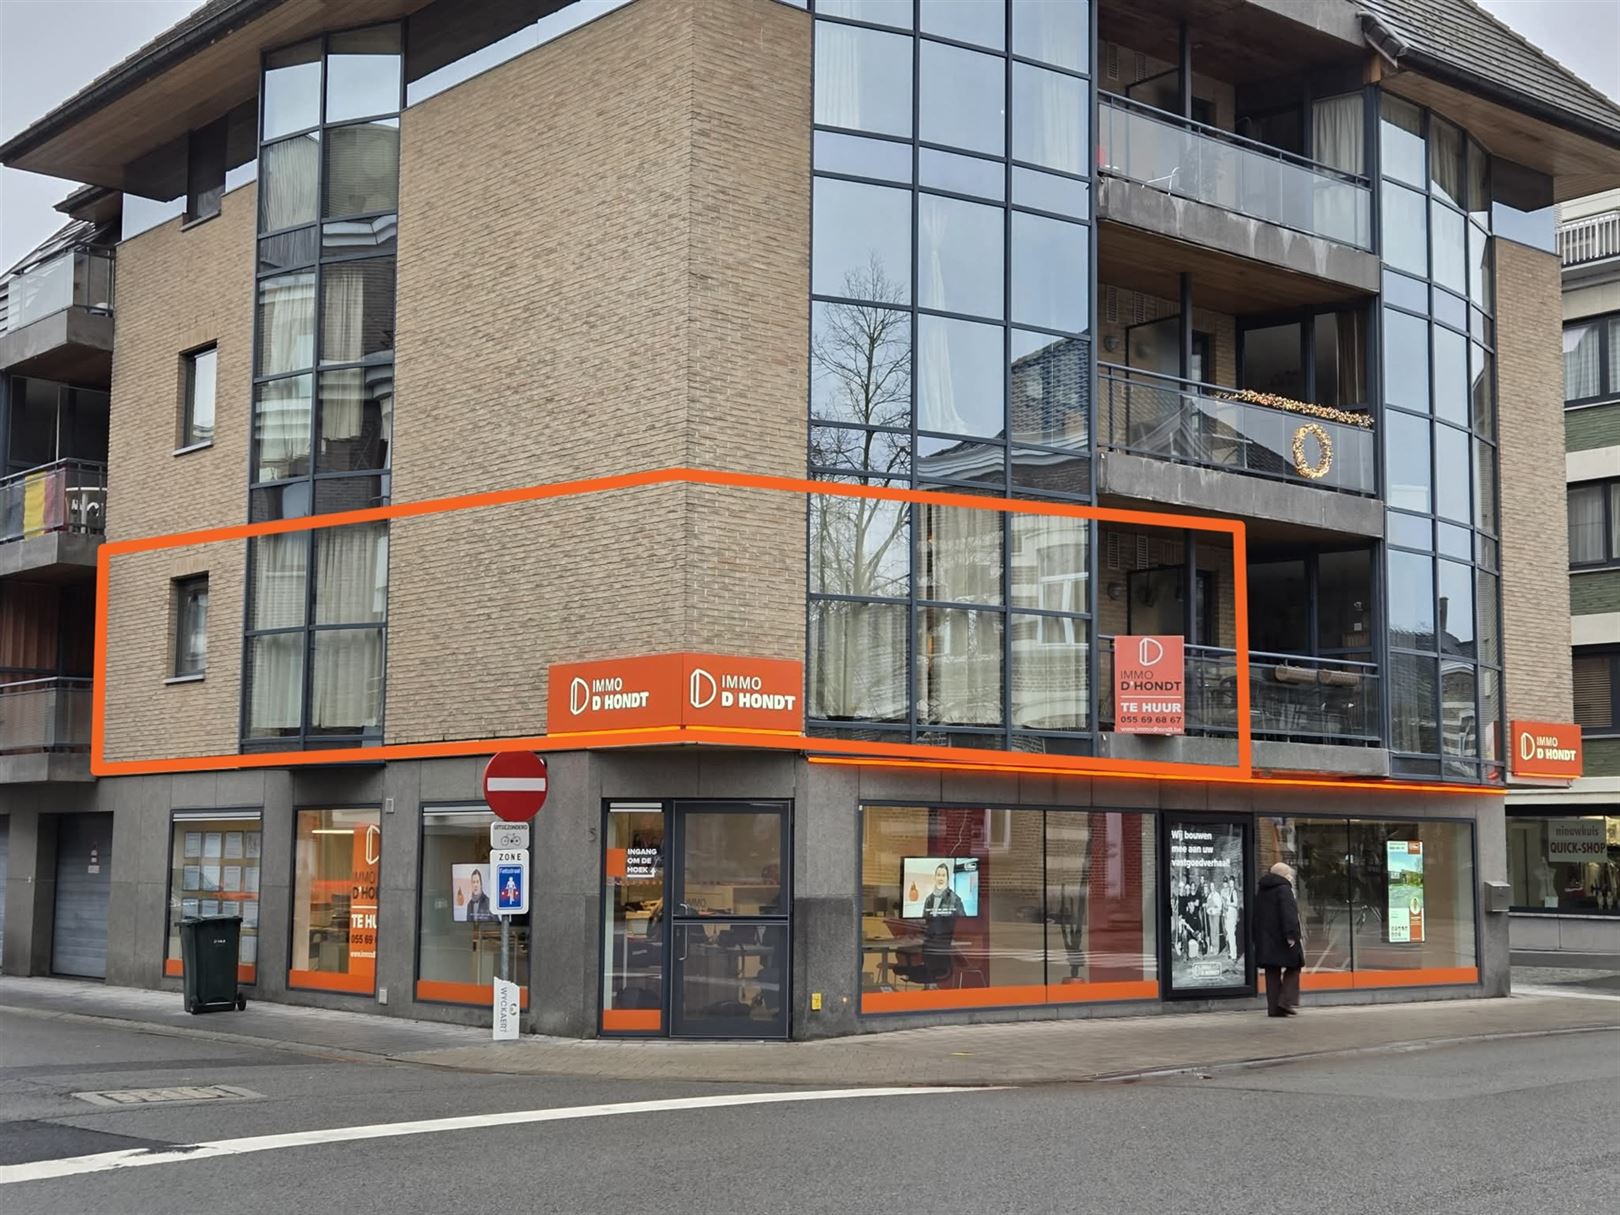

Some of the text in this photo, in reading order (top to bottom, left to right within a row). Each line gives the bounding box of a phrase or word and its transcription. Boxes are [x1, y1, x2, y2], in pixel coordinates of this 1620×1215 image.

[1120, 670, 1153, 680] IMMO
[592, 677, 623, 693] IMMO
[721, 675, 762, 690] IMMO
[1120, 681, 1182, 691] D'HONDT
[1120, 703, 1182, 713] TE HUUR
[1120, 716, 1182, 724] 055 69 68 67
[1536, 735, 1559, 747] IMMO
[1171, 830, 1212, 841] Wij bouwen
[1171, 845, 1187, 853] mee
[1188, 845, 1202, 853] aan
[1550, 841, 1606, 854] QUICK-SHOP
[499, 853, 522, 861] ZONE
[351, 914, 364, 929] TE
[499, 986, 508, 1033] WYCKAERT
